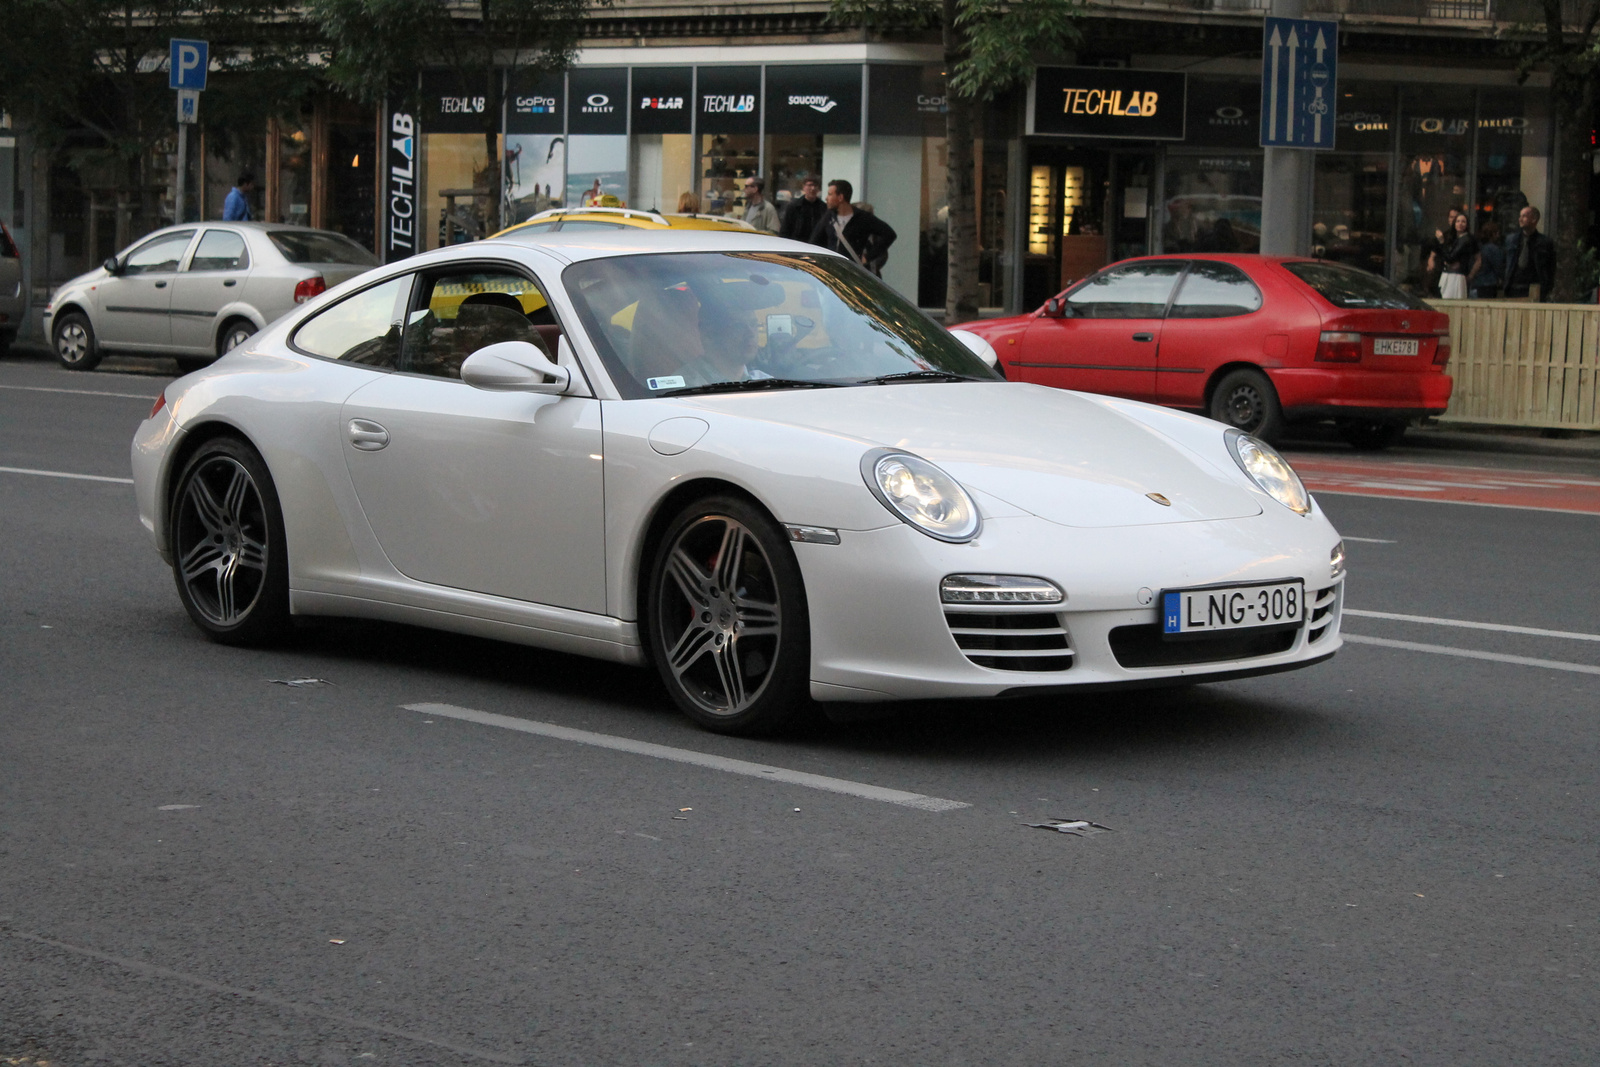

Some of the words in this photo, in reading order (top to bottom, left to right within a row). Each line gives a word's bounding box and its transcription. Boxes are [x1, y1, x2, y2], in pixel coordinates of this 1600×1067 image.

[178, 45, 200, 84] P
[441, 97, 485, 113] TECHLAB
[516, 96, 556, 107] GoPro
[641, 97, 683, 109] POLAR
[703, 94, 755, 113] TECHLAB
[788, 95, 827, 106] saucony
[1062, 88, 1159, 117] TECHLAB
[1478, 118, 1513, 128] OAKLEY
[391, 112, 414, 251] TECHLAB
[1187, 587, 1297, 627] LNG-308
[1168, 615, 1177, 627] H
